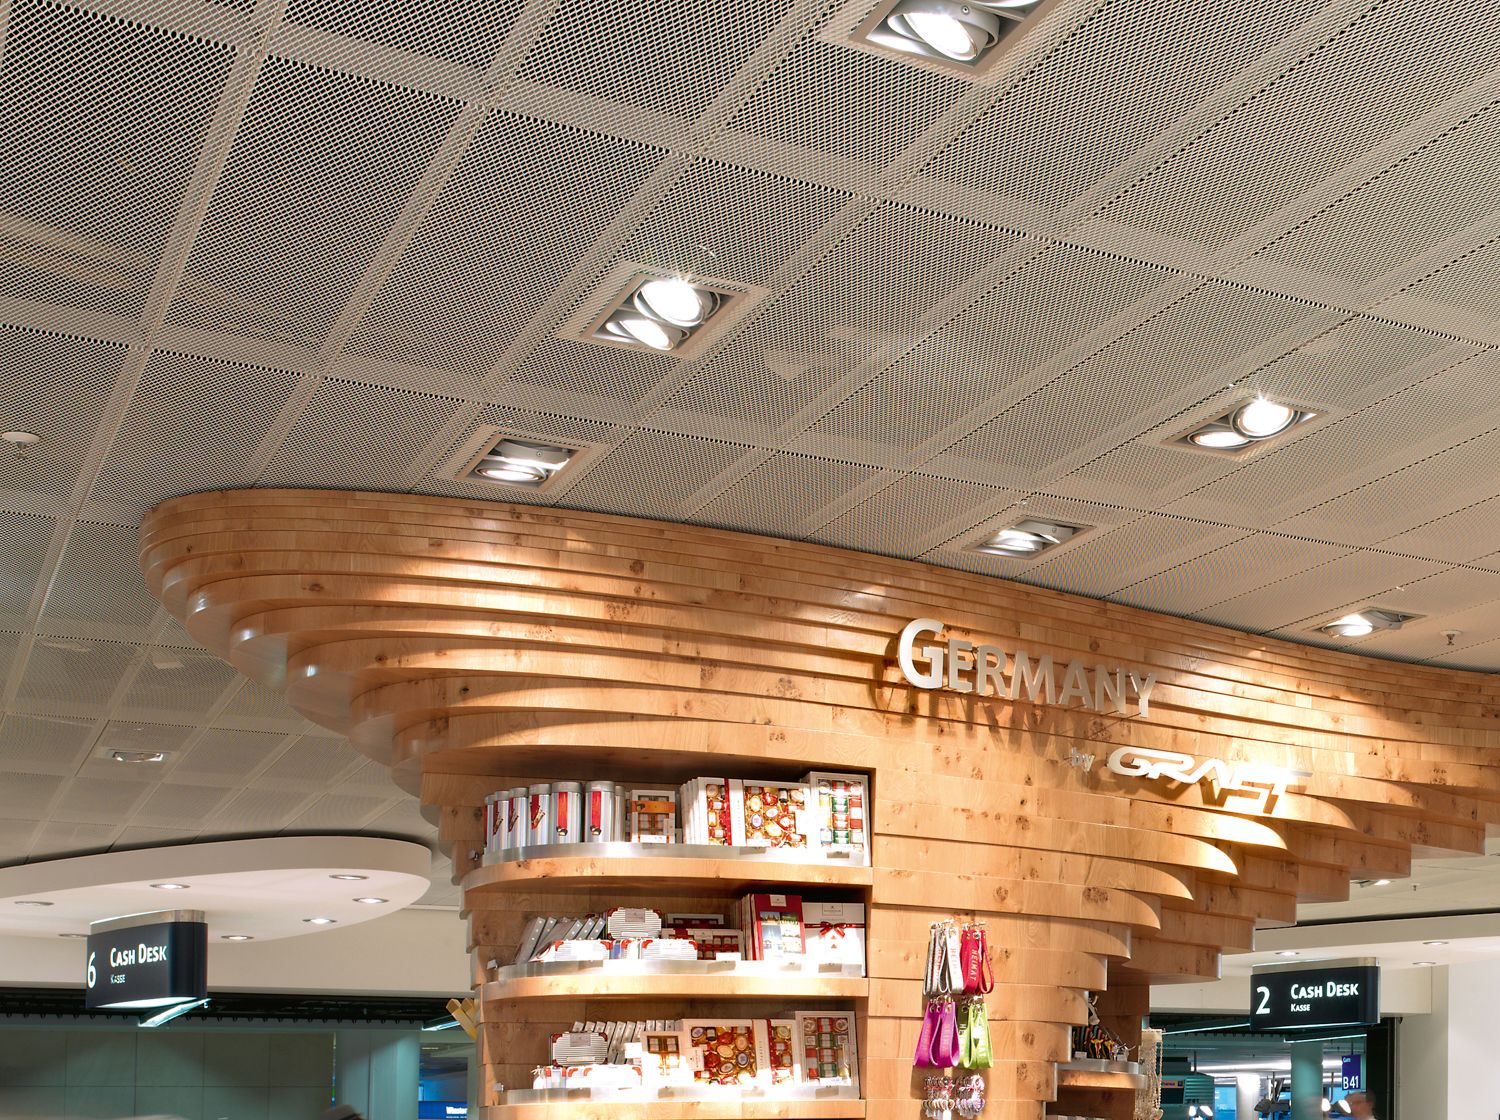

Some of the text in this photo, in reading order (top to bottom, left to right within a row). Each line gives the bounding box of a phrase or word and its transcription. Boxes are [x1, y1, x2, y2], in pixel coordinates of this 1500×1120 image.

[898, 618, 1158, 718] GERMANY
[1071, 746, 1313, 796] by GRAFT
[110, 943, 167, 967] CASH DESK
[87, 951, 97, 989] 6
[1255, 986, 1271, 1015] 2
[1290, 981, 1359, 999] CASH DESK
[1290, 1003, 1311, 1012] KASSE
